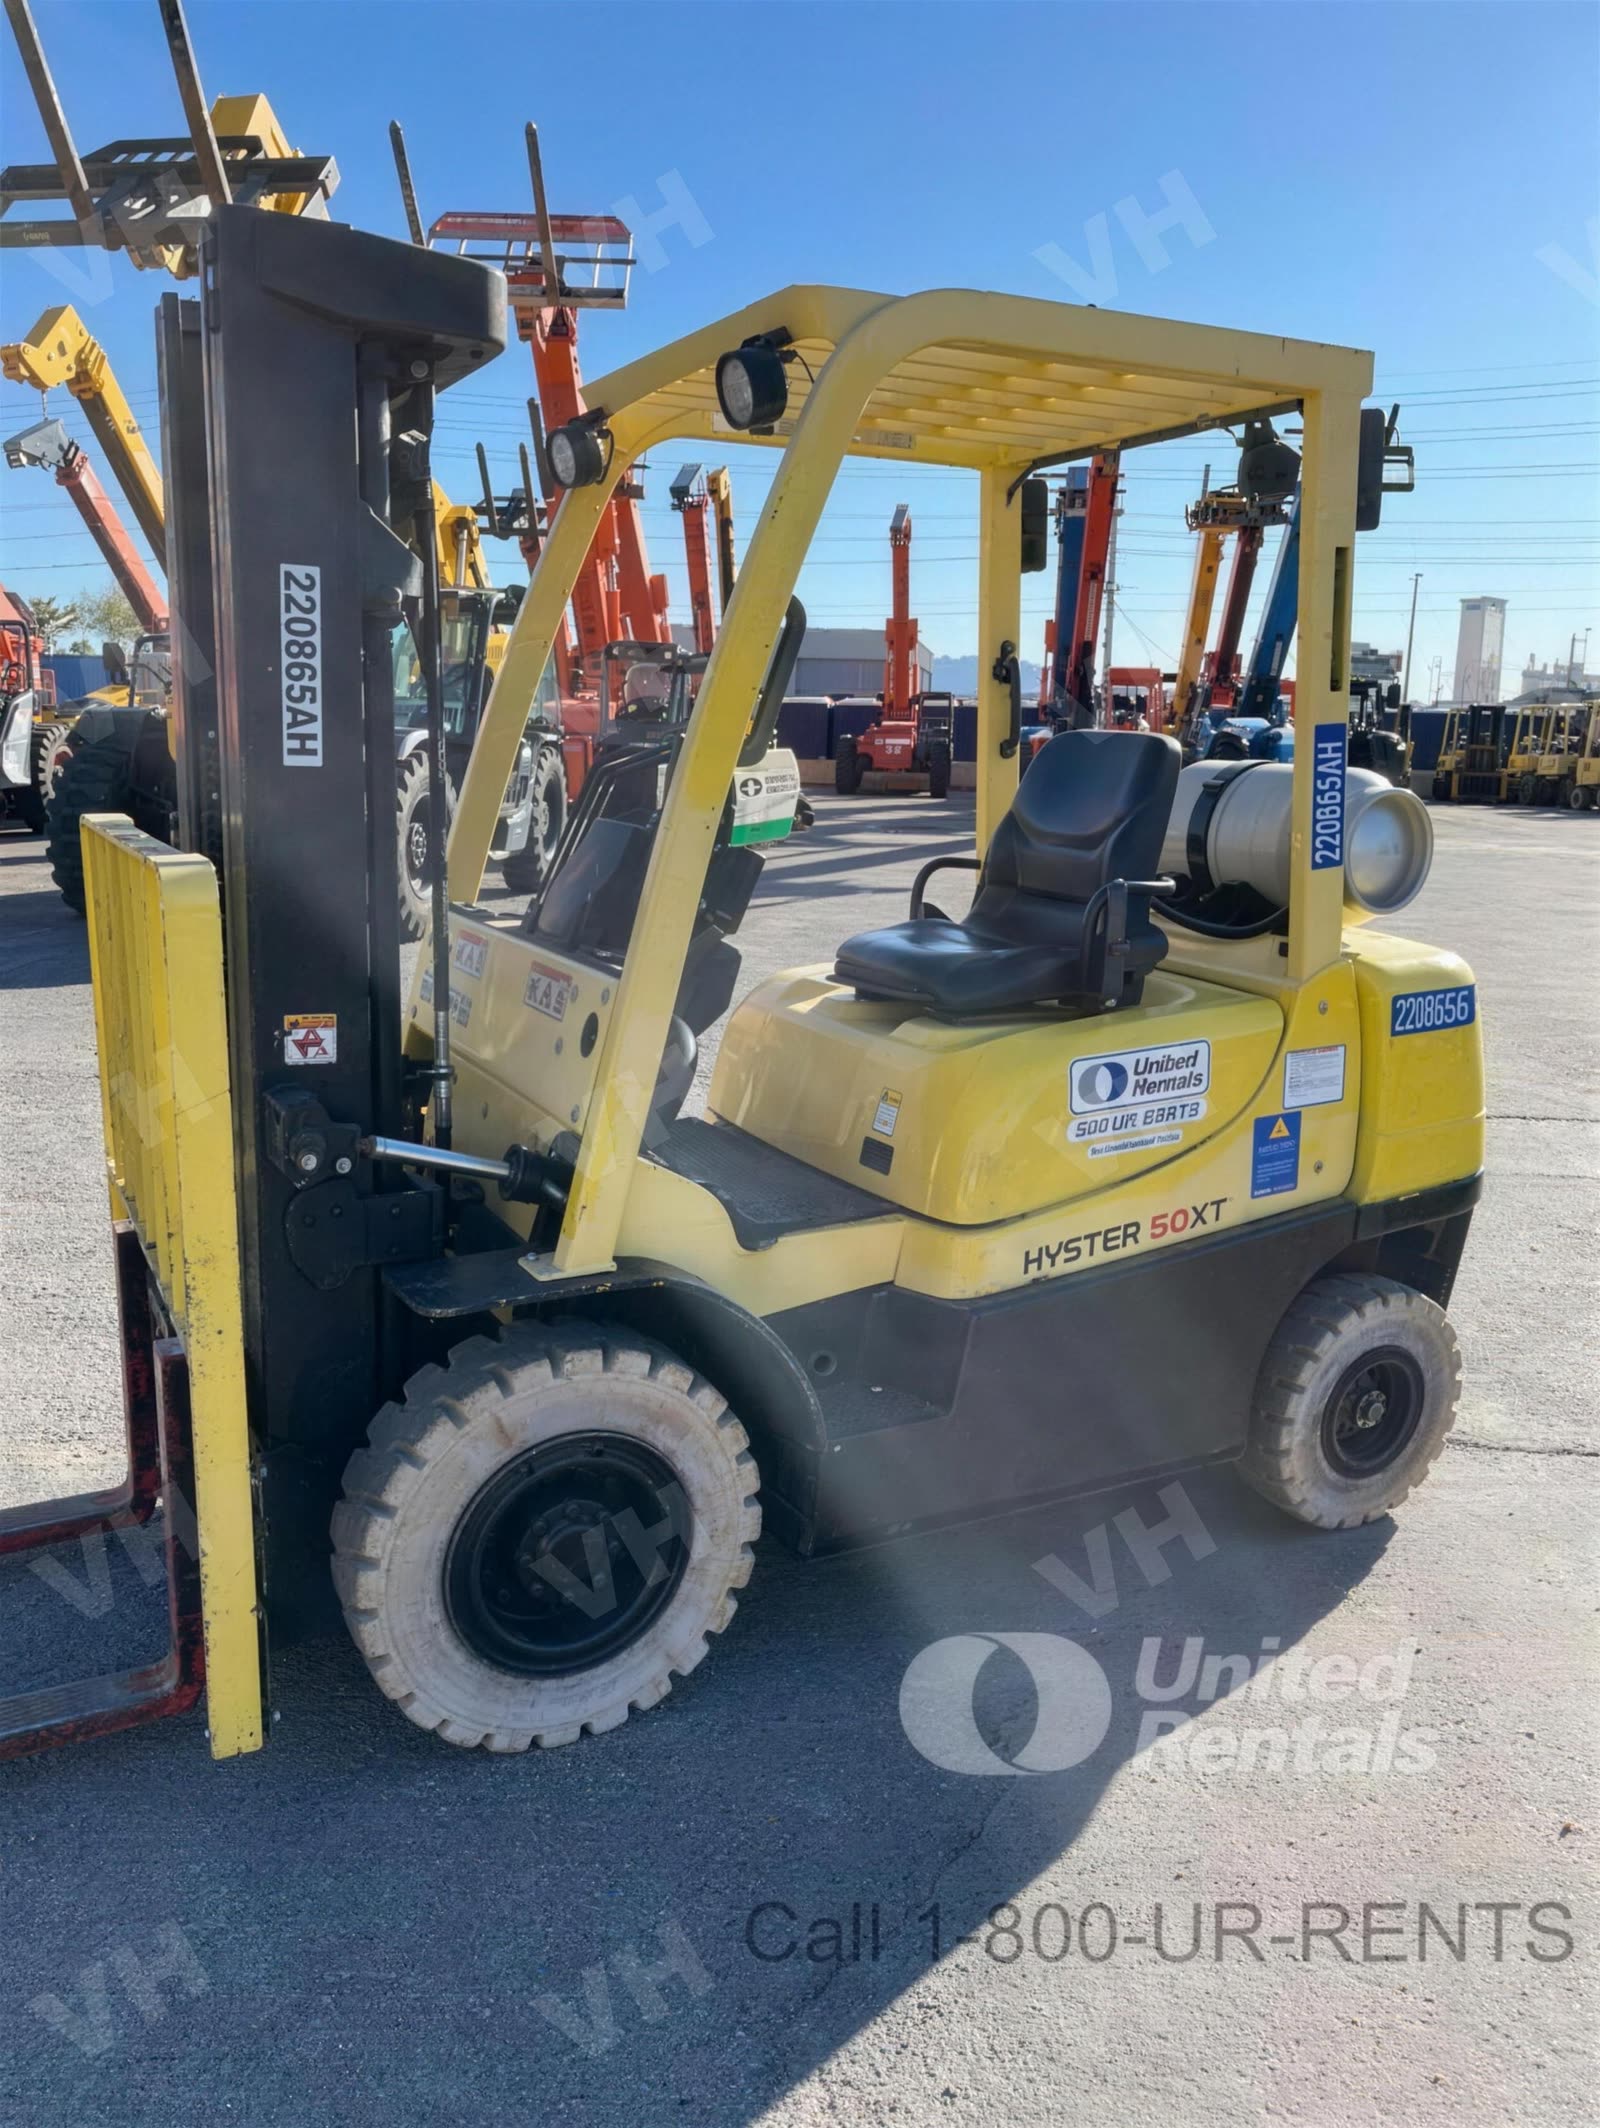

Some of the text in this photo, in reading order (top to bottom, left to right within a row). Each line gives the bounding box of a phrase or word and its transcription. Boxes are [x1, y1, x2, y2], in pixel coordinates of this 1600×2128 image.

[284, 571, 318, 756] 220865AH
[1395, 990, 1469, 1031] 2208656
[1023, 1221, 1141, 1275] HYSTER
